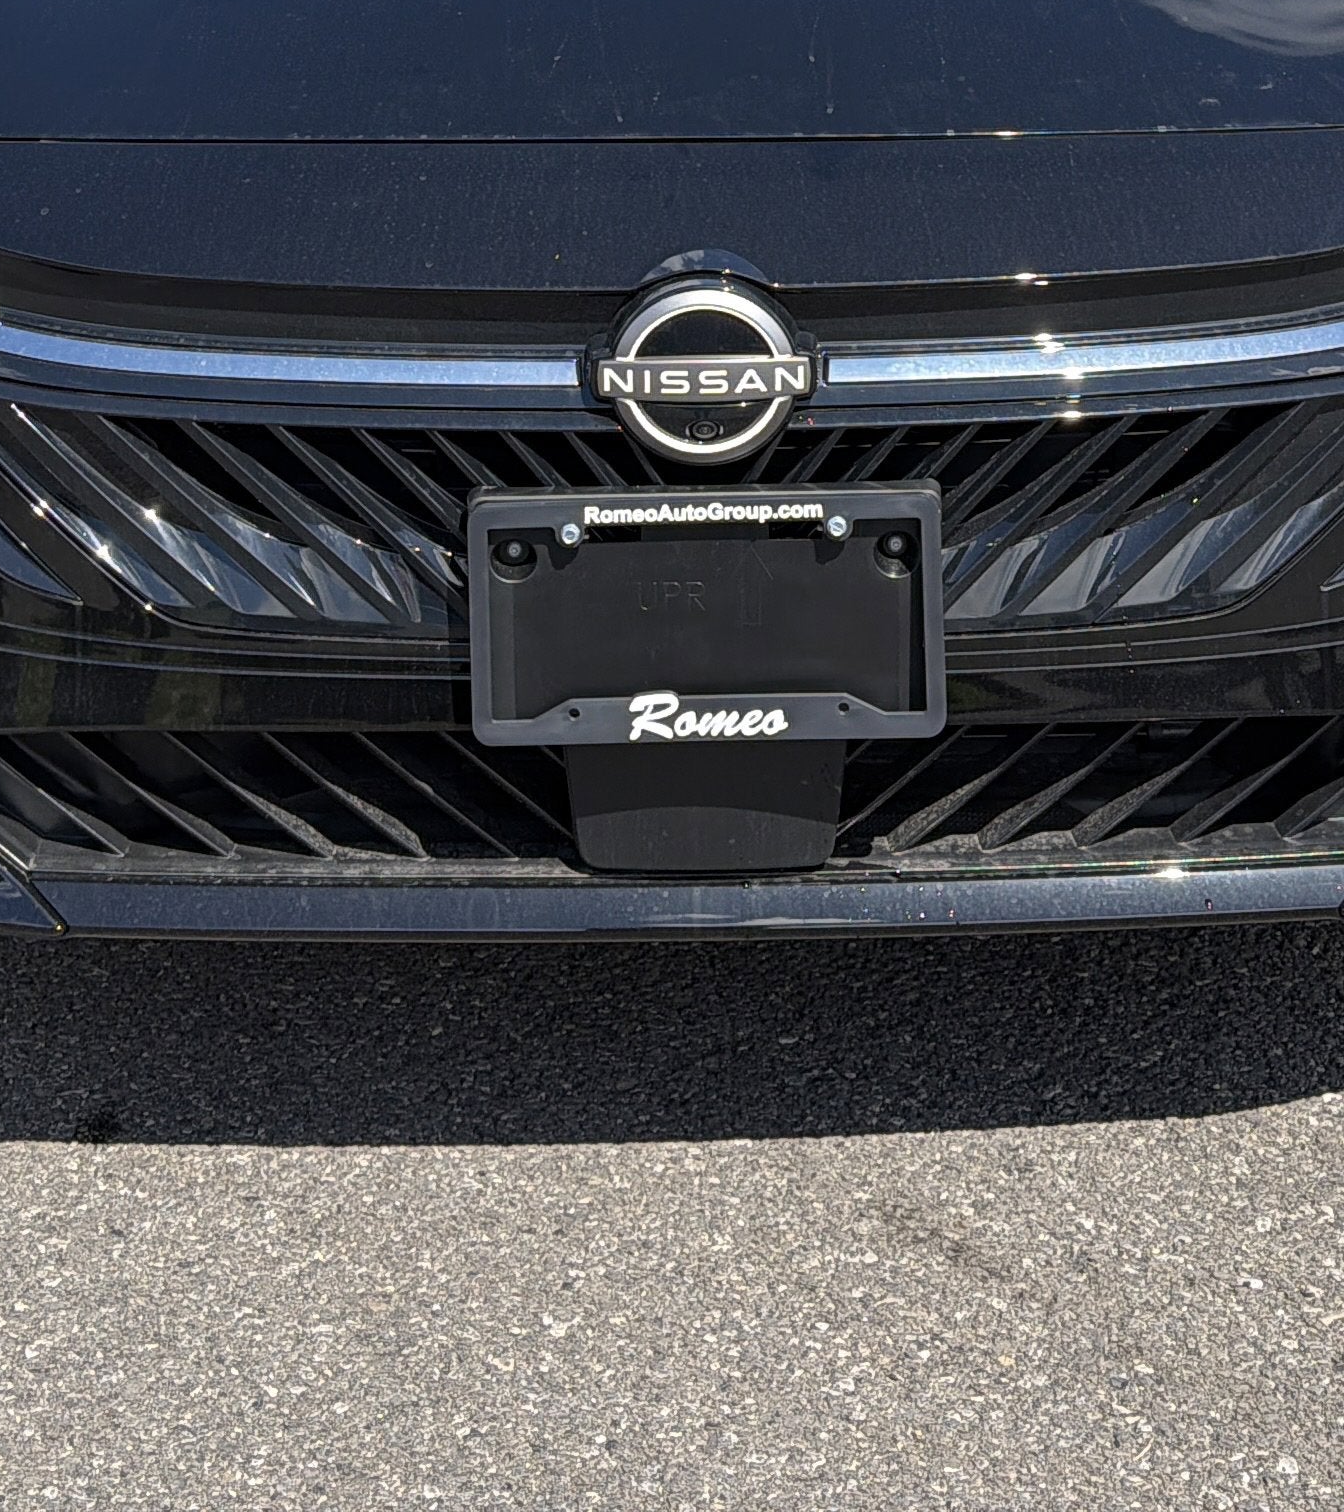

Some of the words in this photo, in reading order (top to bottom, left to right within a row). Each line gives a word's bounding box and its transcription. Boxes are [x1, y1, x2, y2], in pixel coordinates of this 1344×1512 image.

[602, 365, 805, 395] NISSAN
[584, 502, 824, 525] RomeoAutoGroup.com
[629, 693, 789, 741] Romeo
